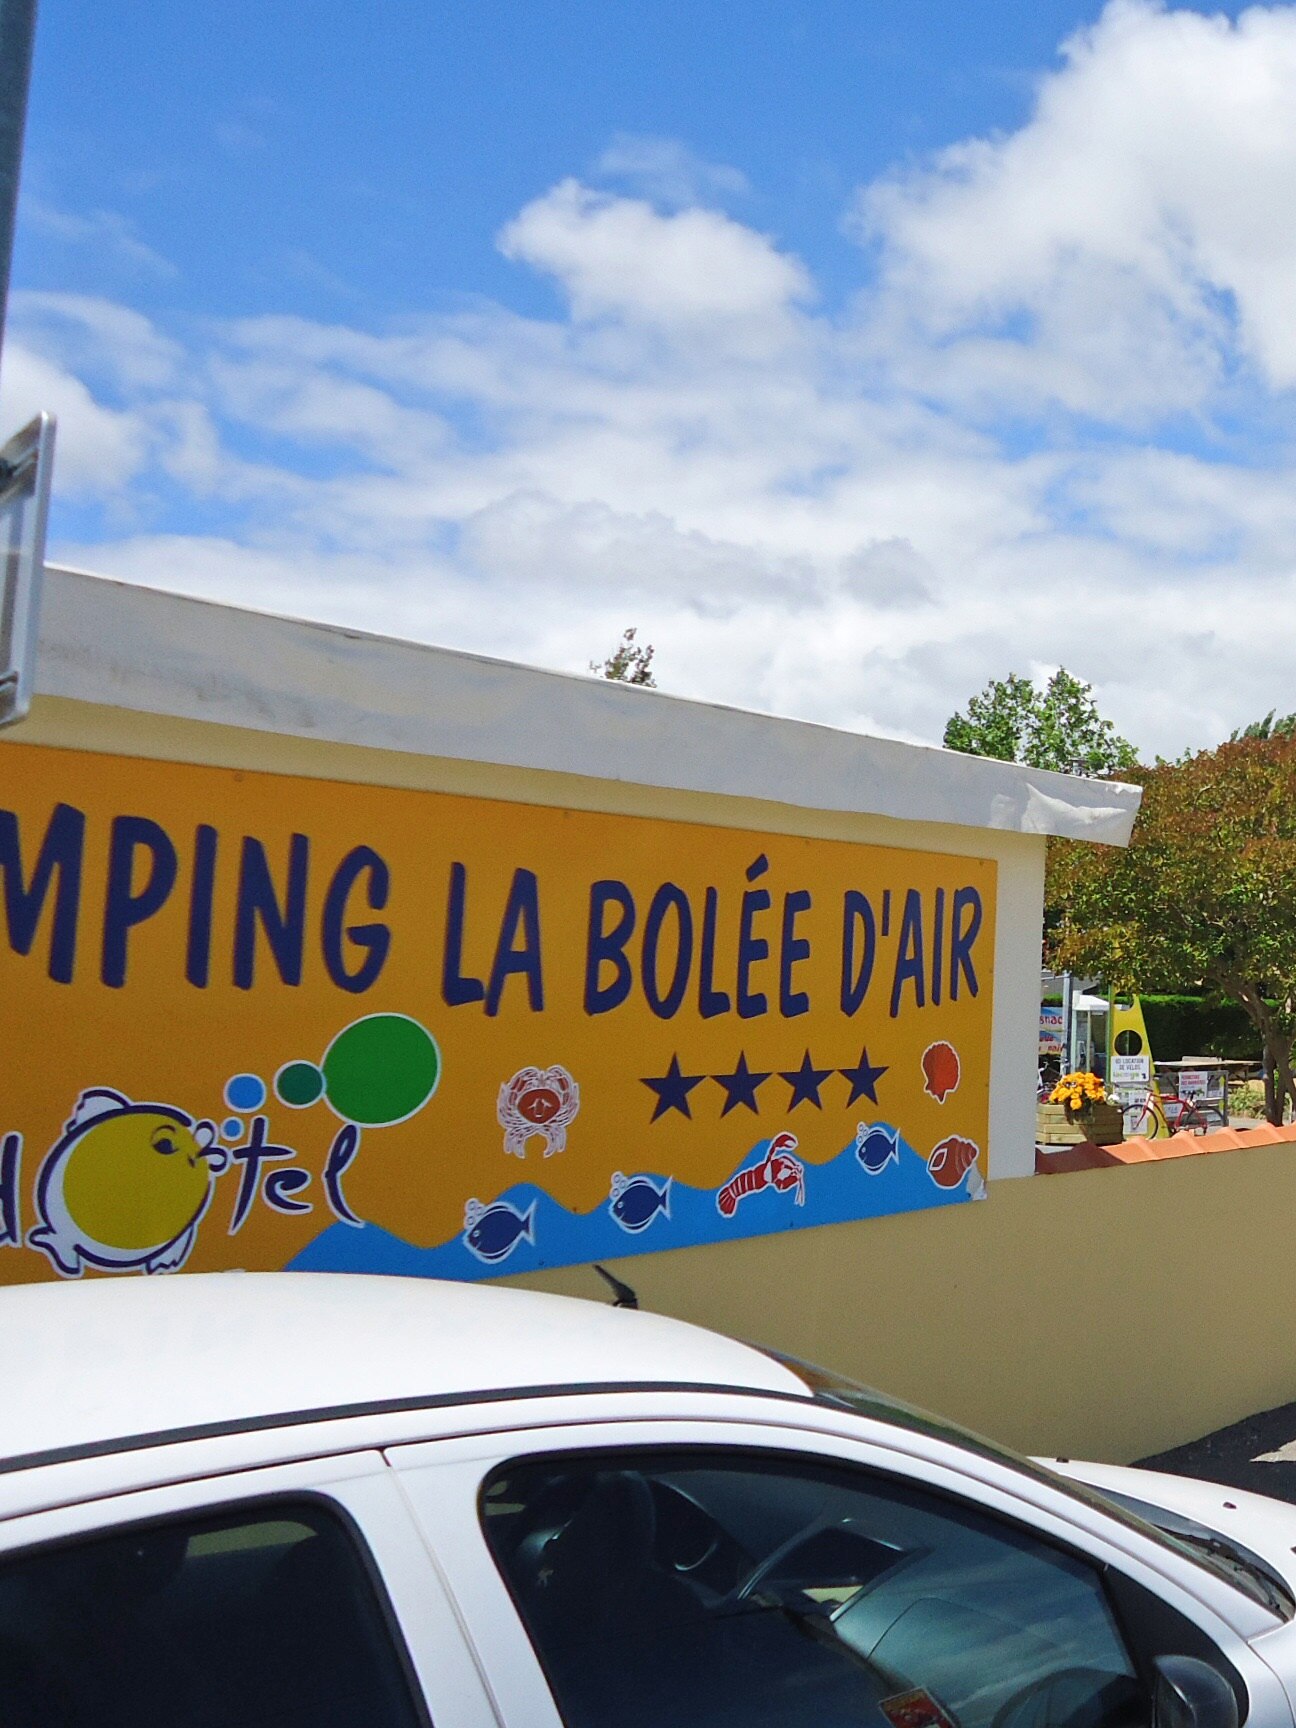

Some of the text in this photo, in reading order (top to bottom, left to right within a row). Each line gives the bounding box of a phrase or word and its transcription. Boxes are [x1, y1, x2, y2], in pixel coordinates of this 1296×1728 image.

[441, 861, 544, 1017] LA
[583, 853, 811, 1020] BOLÉE
[840, 886, 982, 1018] D'AIR
